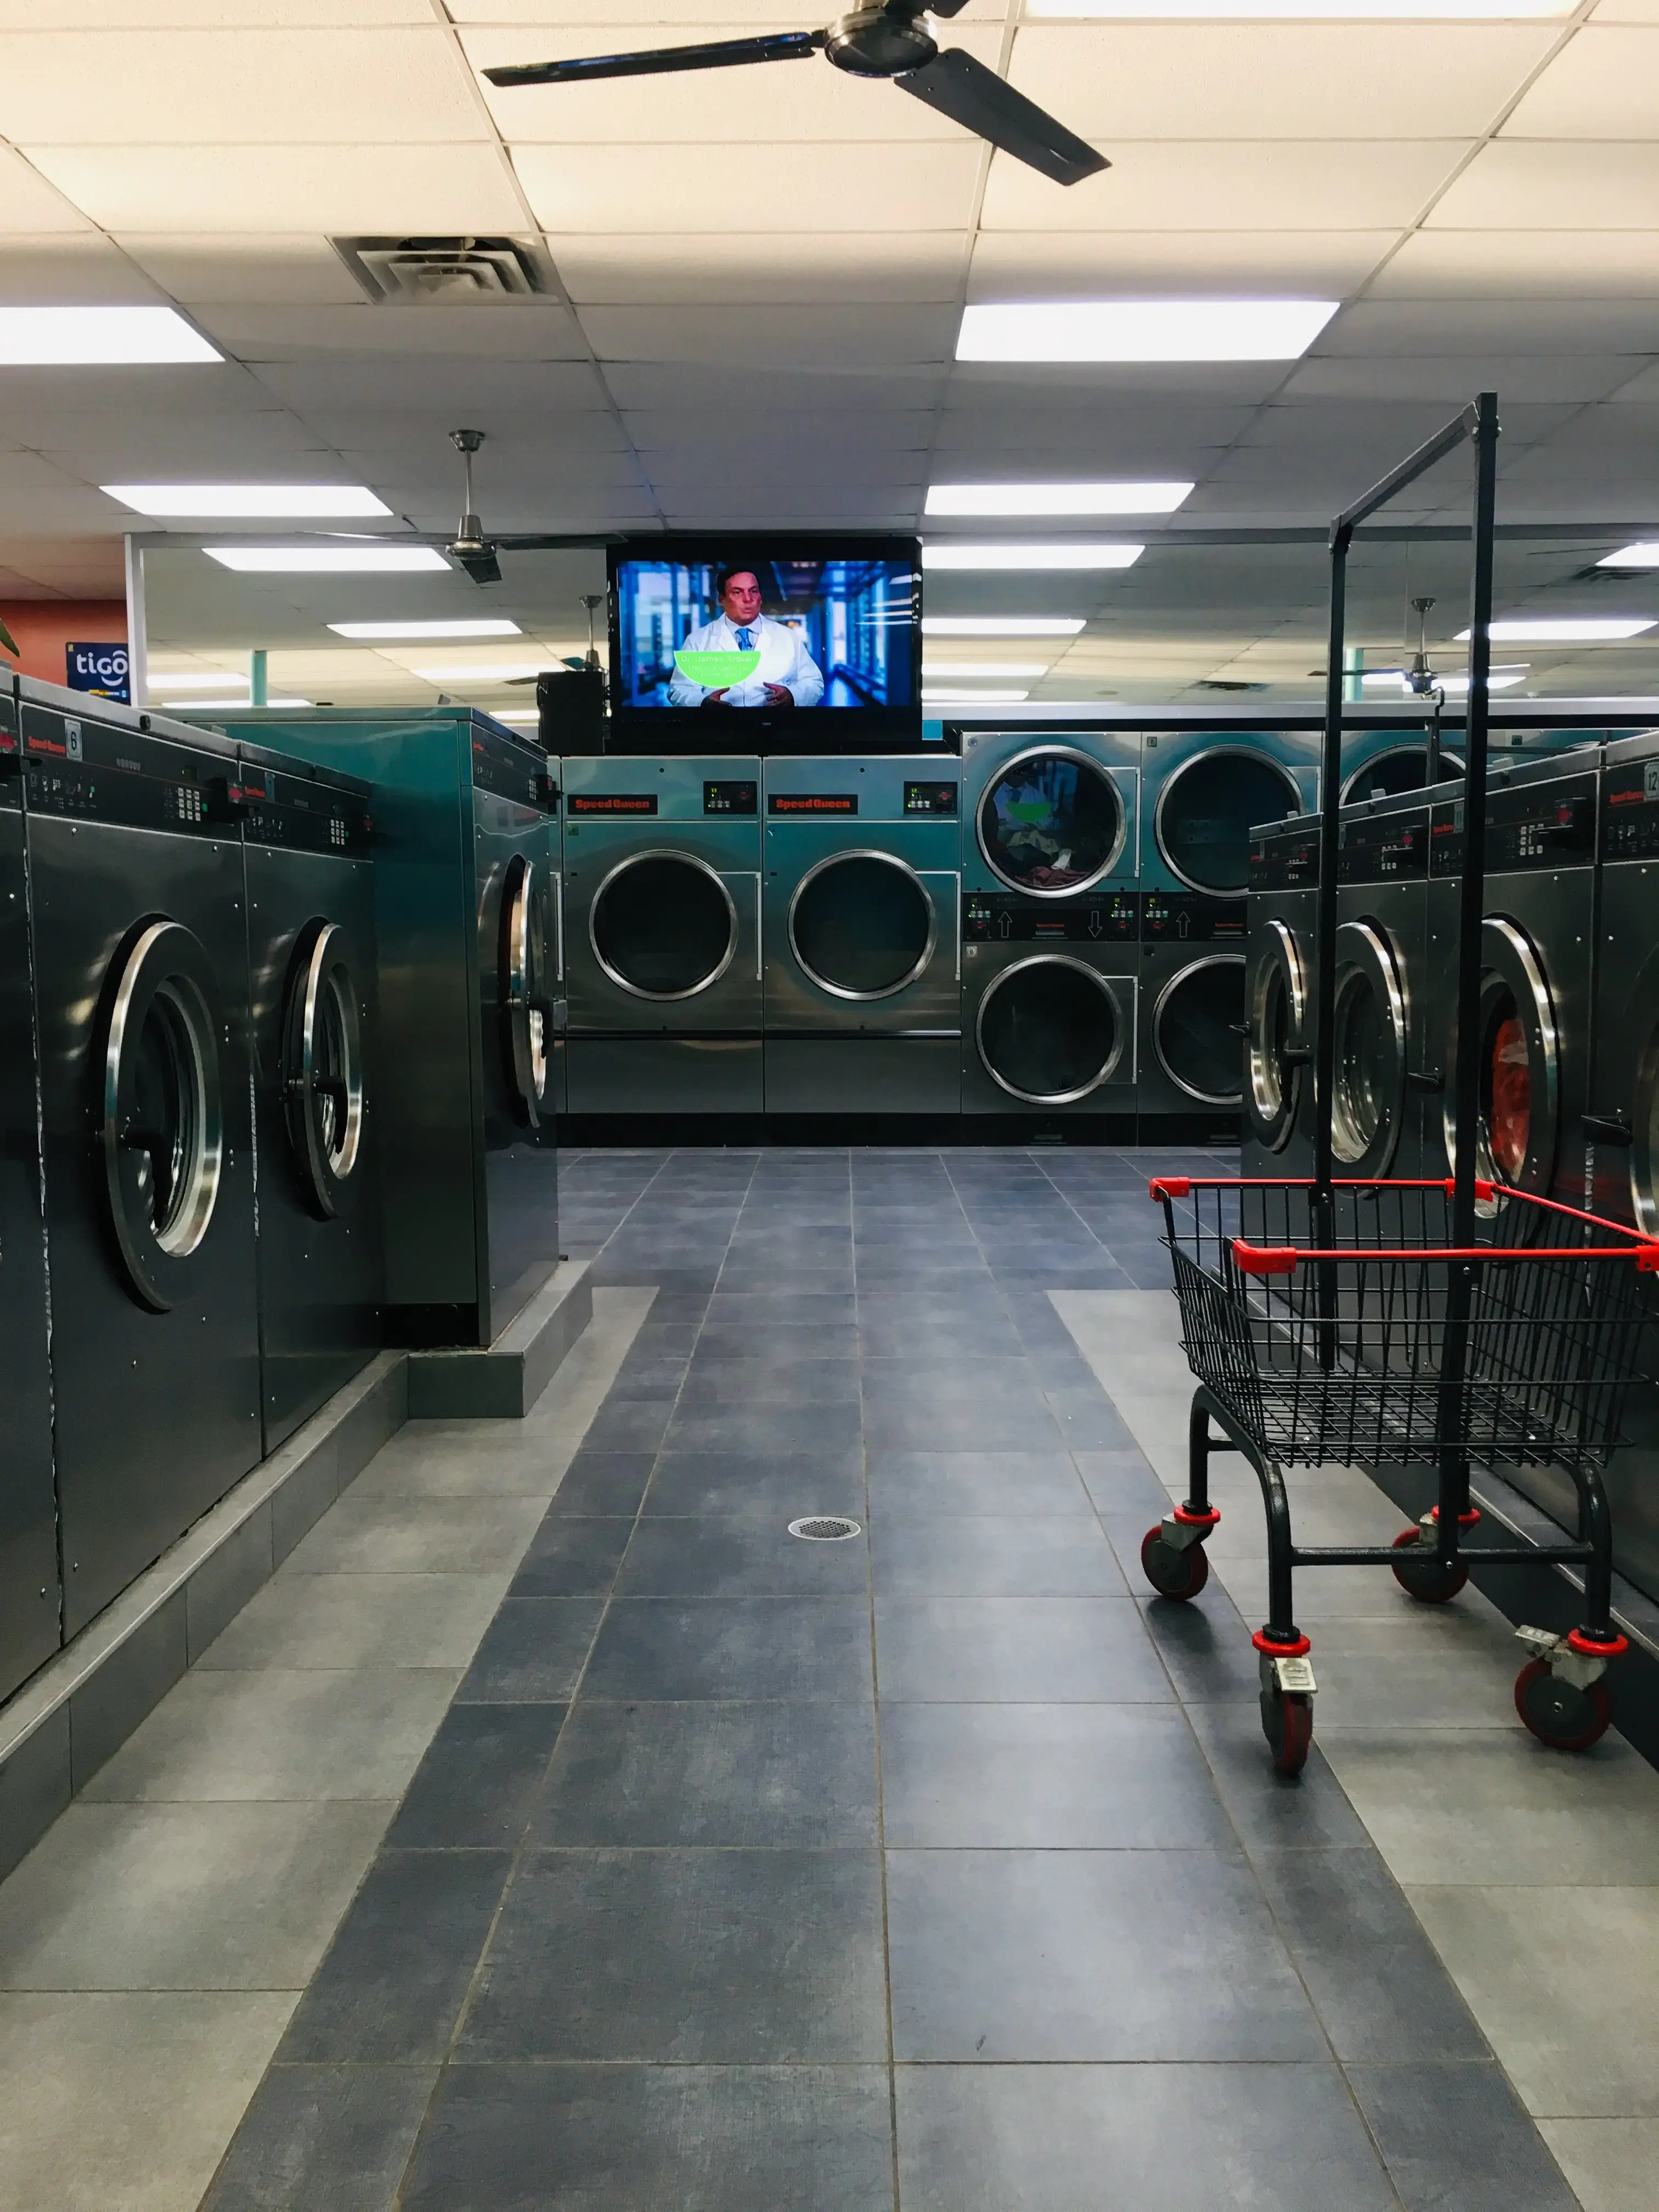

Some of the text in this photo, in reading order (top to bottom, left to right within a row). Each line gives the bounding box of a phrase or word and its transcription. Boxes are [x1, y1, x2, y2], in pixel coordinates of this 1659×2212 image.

[70, 731, 77, 751] 6
[1648, 771, 1658, 791] 12
[575, 799, 650, 810] Speed Queen
[776, 799, 850, 810] Speed Queen
